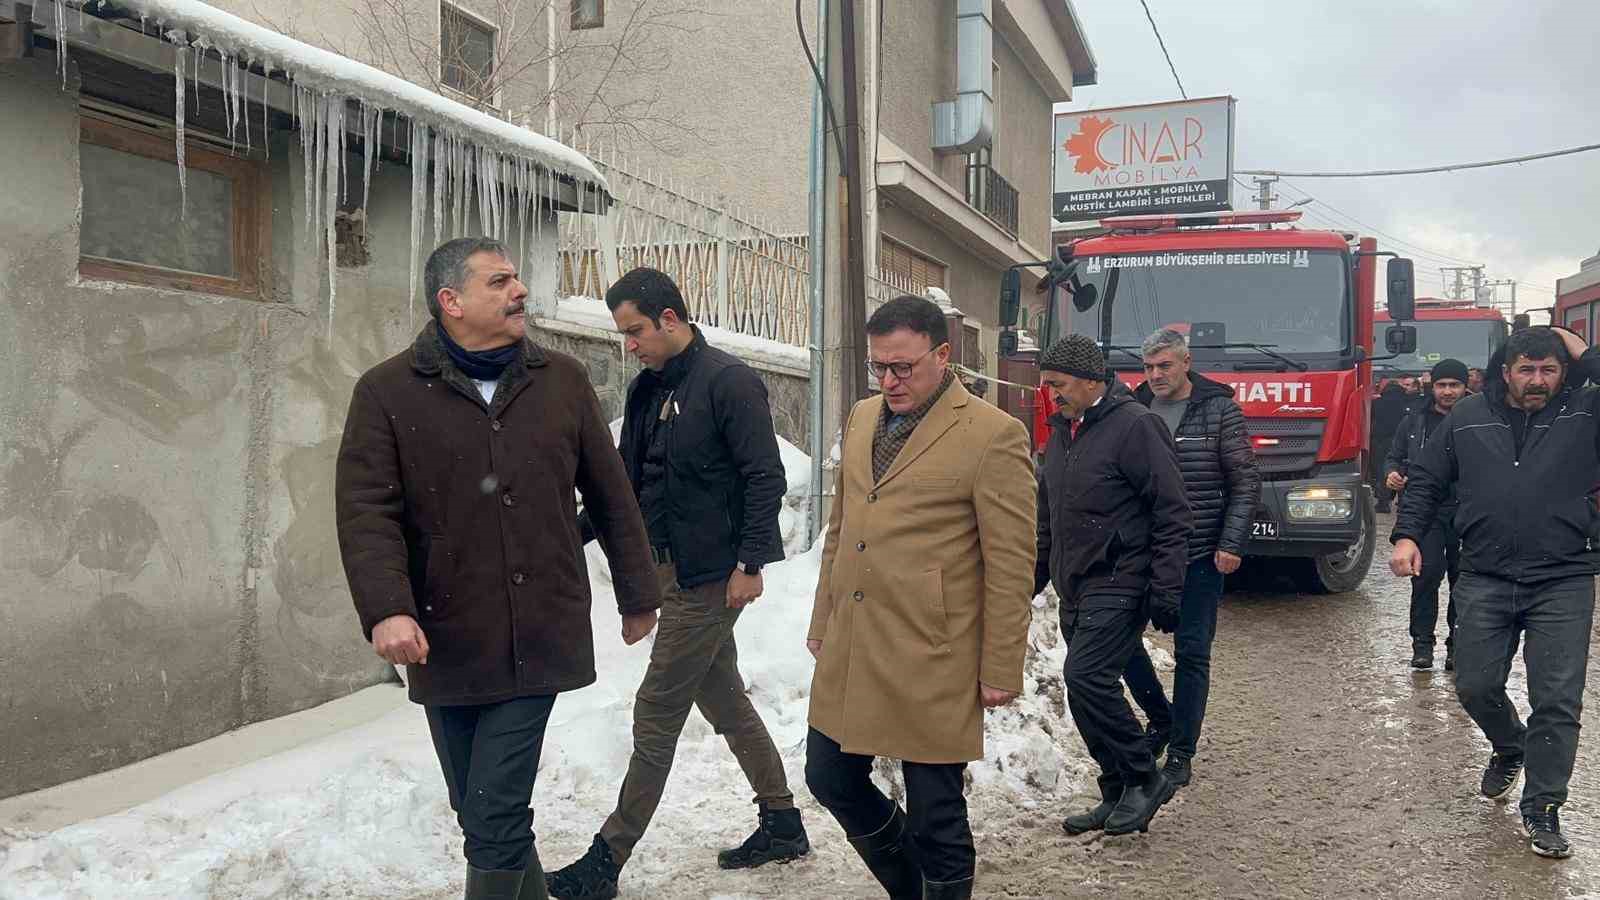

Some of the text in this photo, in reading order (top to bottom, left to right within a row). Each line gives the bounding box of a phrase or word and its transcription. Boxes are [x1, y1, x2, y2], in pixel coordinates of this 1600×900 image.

[1062, 191, 1215, 212] AKUSTİK LAMBİRİ SİSTEMLERİ
[1070, 191, 1113, 202] MEBRAN
[1116, 188, 1151, 198] KAPAK
[1161, 183, 1208, 194] MOBİLYA
[1103, 251, 1290, 268] ERZURUM BÜYÜKŞEHİR BELEDİYESİ
[1252, 522, 1275, 536] 214
